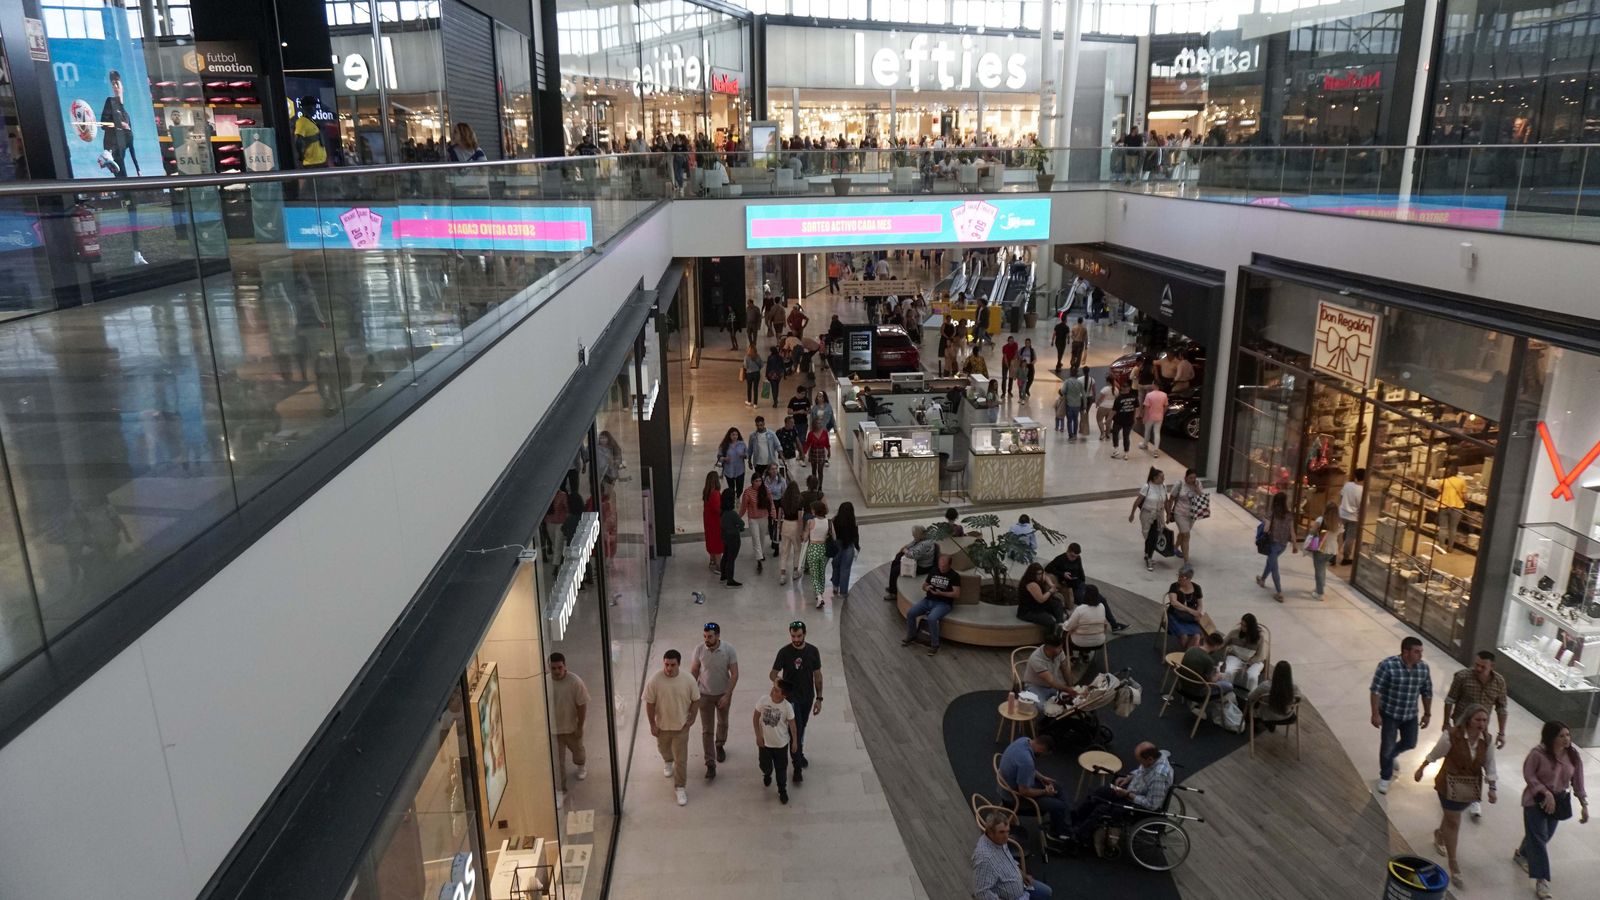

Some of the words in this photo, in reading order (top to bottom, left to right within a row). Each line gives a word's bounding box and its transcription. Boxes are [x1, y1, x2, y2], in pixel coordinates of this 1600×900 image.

[207, 52, 237, 62] futbol
[853, 32, 1027, 90] lefties
[1174, 44, 1260, 74] merkal
[208, 62, 253, 73] emotion
[297, 109, 334, 120] etion
[248, 155, 271, 163] SALE
[801, 220, 831, 233] SORTEO
[831, 219, 857, 232] ACTIVO
[857, 219, 876, 232] CADA
[876, 218, 892, 231] MES
[1320, 308, 1337, 324] Don
[1337, 313, 1371, 334] Regalón
